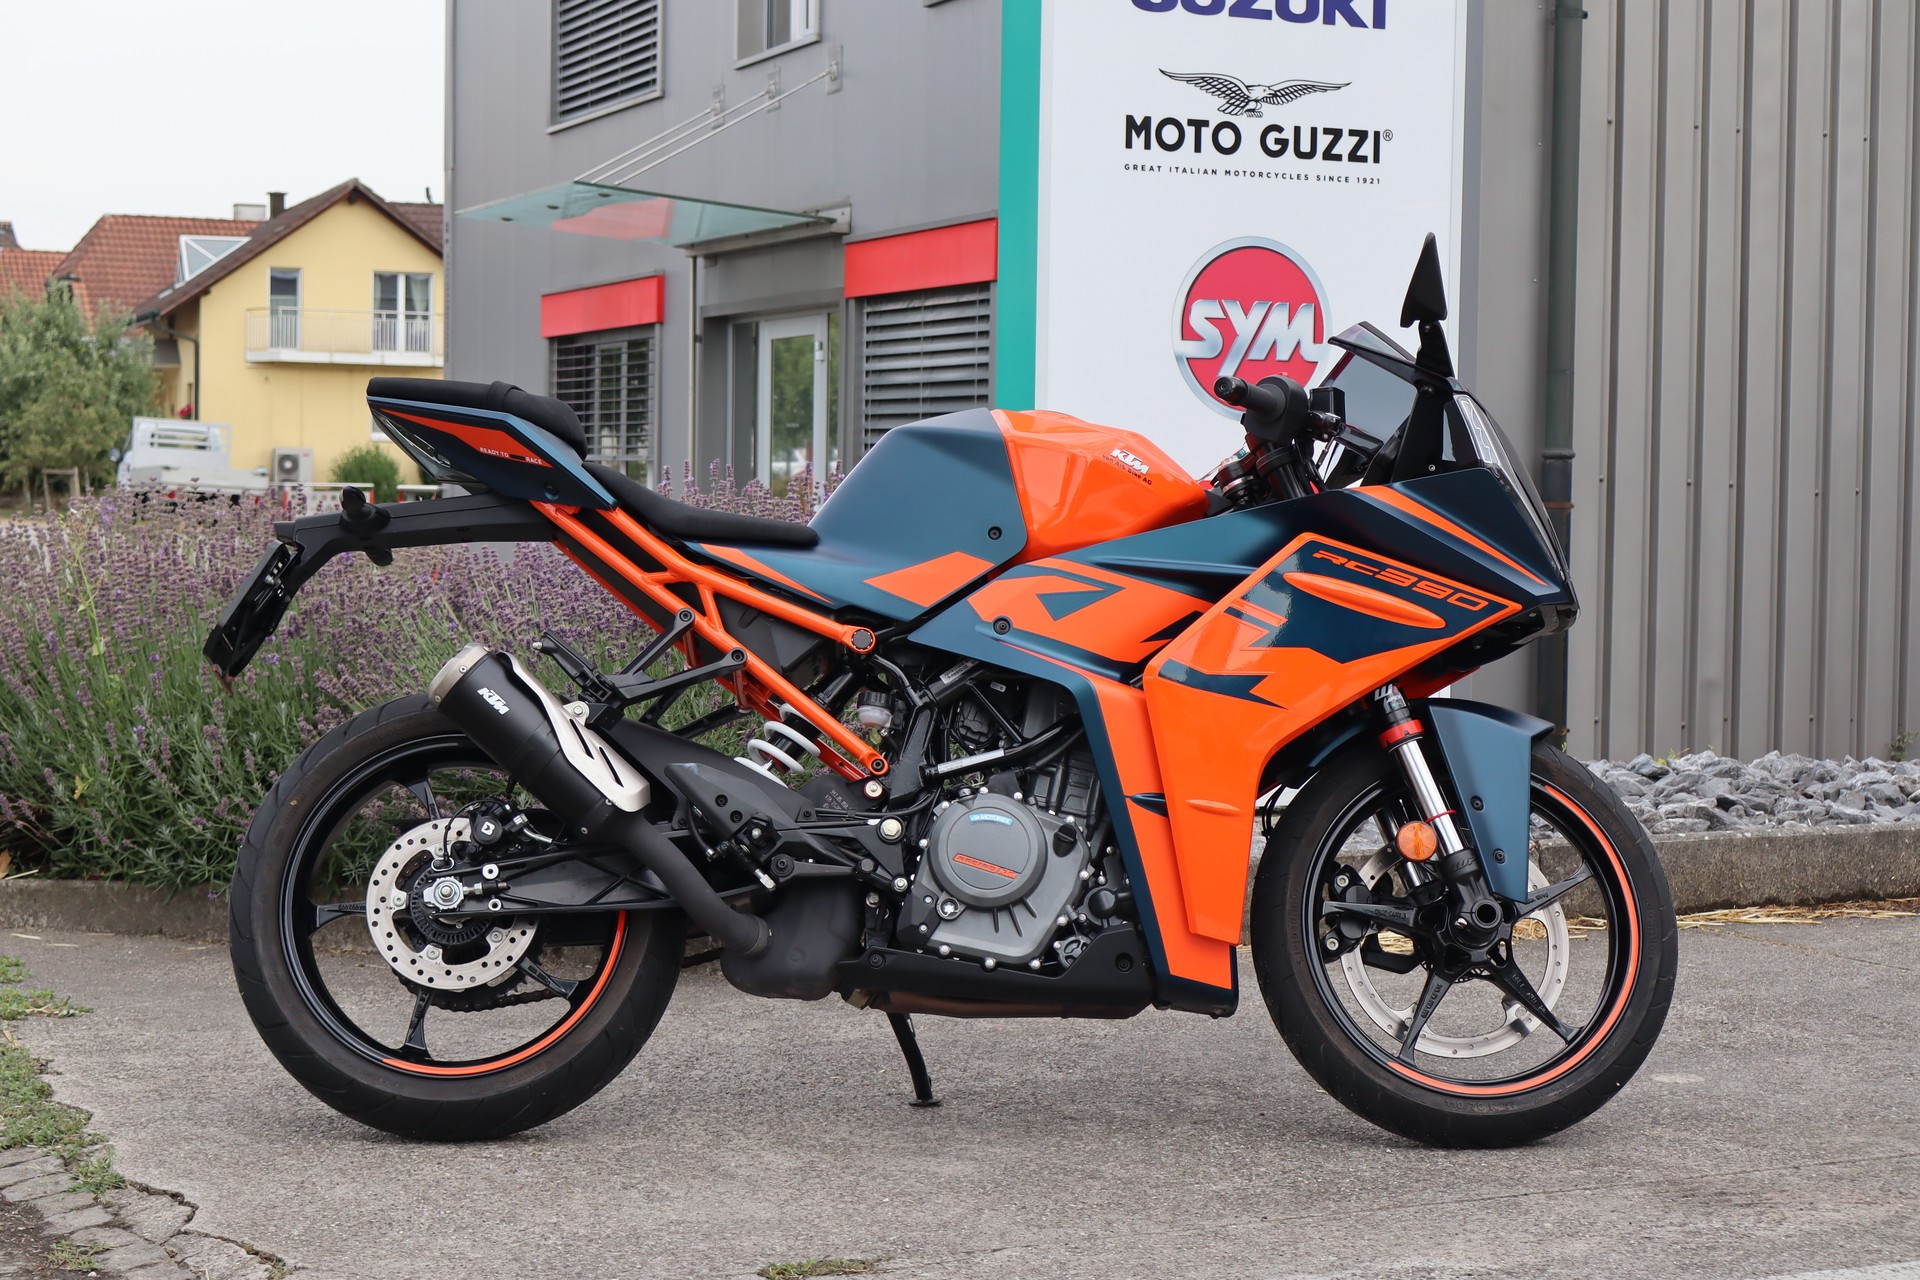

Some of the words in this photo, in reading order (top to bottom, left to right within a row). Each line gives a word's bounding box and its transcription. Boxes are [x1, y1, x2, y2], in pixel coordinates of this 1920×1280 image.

[1125, 114, 1242, 156] MOTO
[1124, 163, 1162, 172] GREAT
[1169, 166, 1218, 175] ITALIAN
[1224, 169, 1309, 181] MOTORCYCLES
[1316, 174, 1350, 183] SINCE
[1356, 176, 1380, 185] 1921
[1175, 298, 1323, 378] SYM
[479, 446, 500, 456] READY
[500, 450, 509, 458] TO
[525, 456, 543, 465] RACE
[1110, 448, 1150, 475] KTM
[1312, 549, 1490, 611] RC390
[476, 687, 510, 715] KTM
